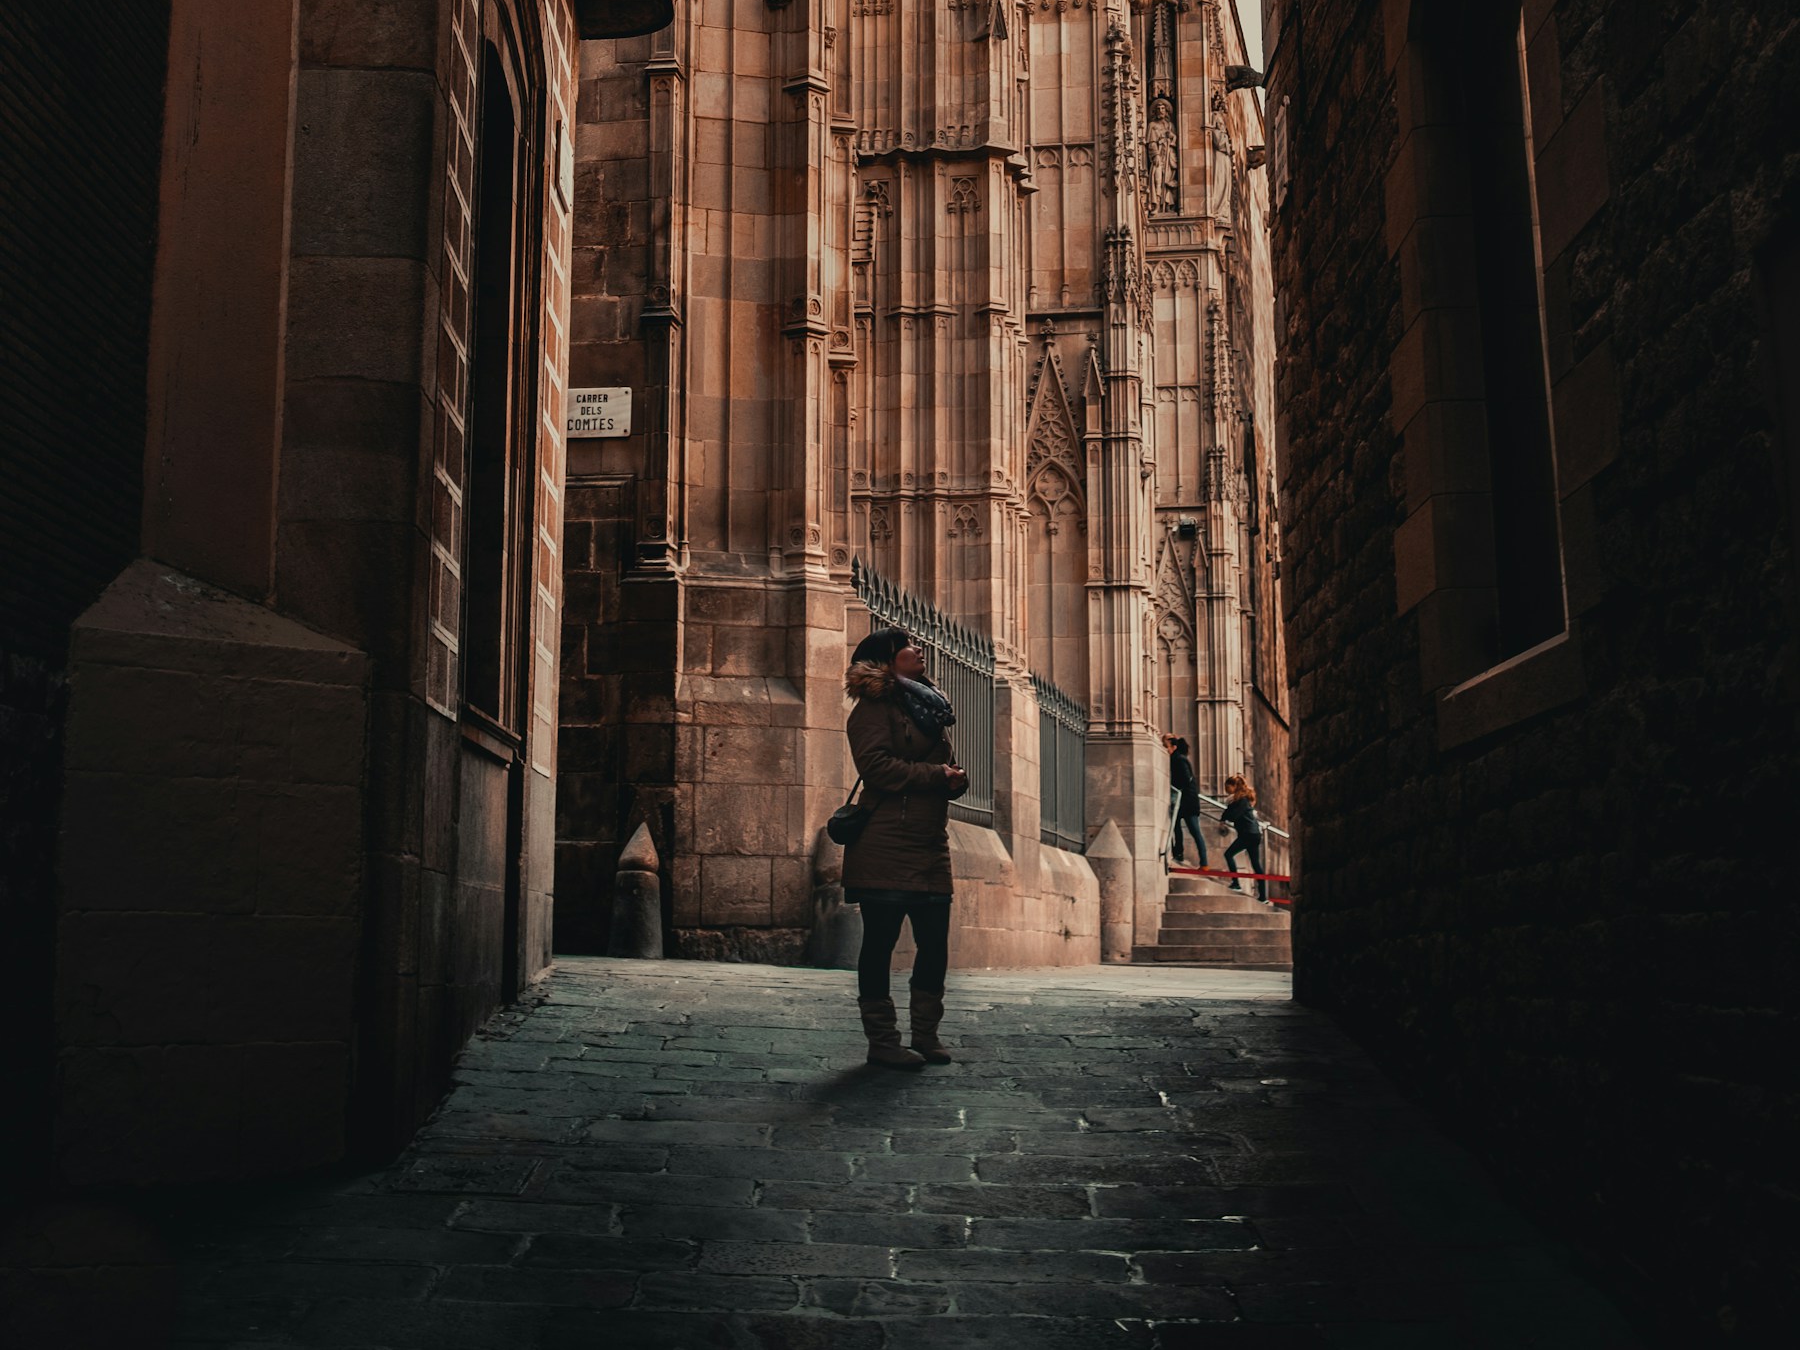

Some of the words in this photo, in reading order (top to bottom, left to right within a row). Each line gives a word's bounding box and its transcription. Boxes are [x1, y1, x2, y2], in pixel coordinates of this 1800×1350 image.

[577, 394, 608, 403] CARRER
[581, 406, 602, 415] DELS
[567, 419, 614, 431] COMTES
